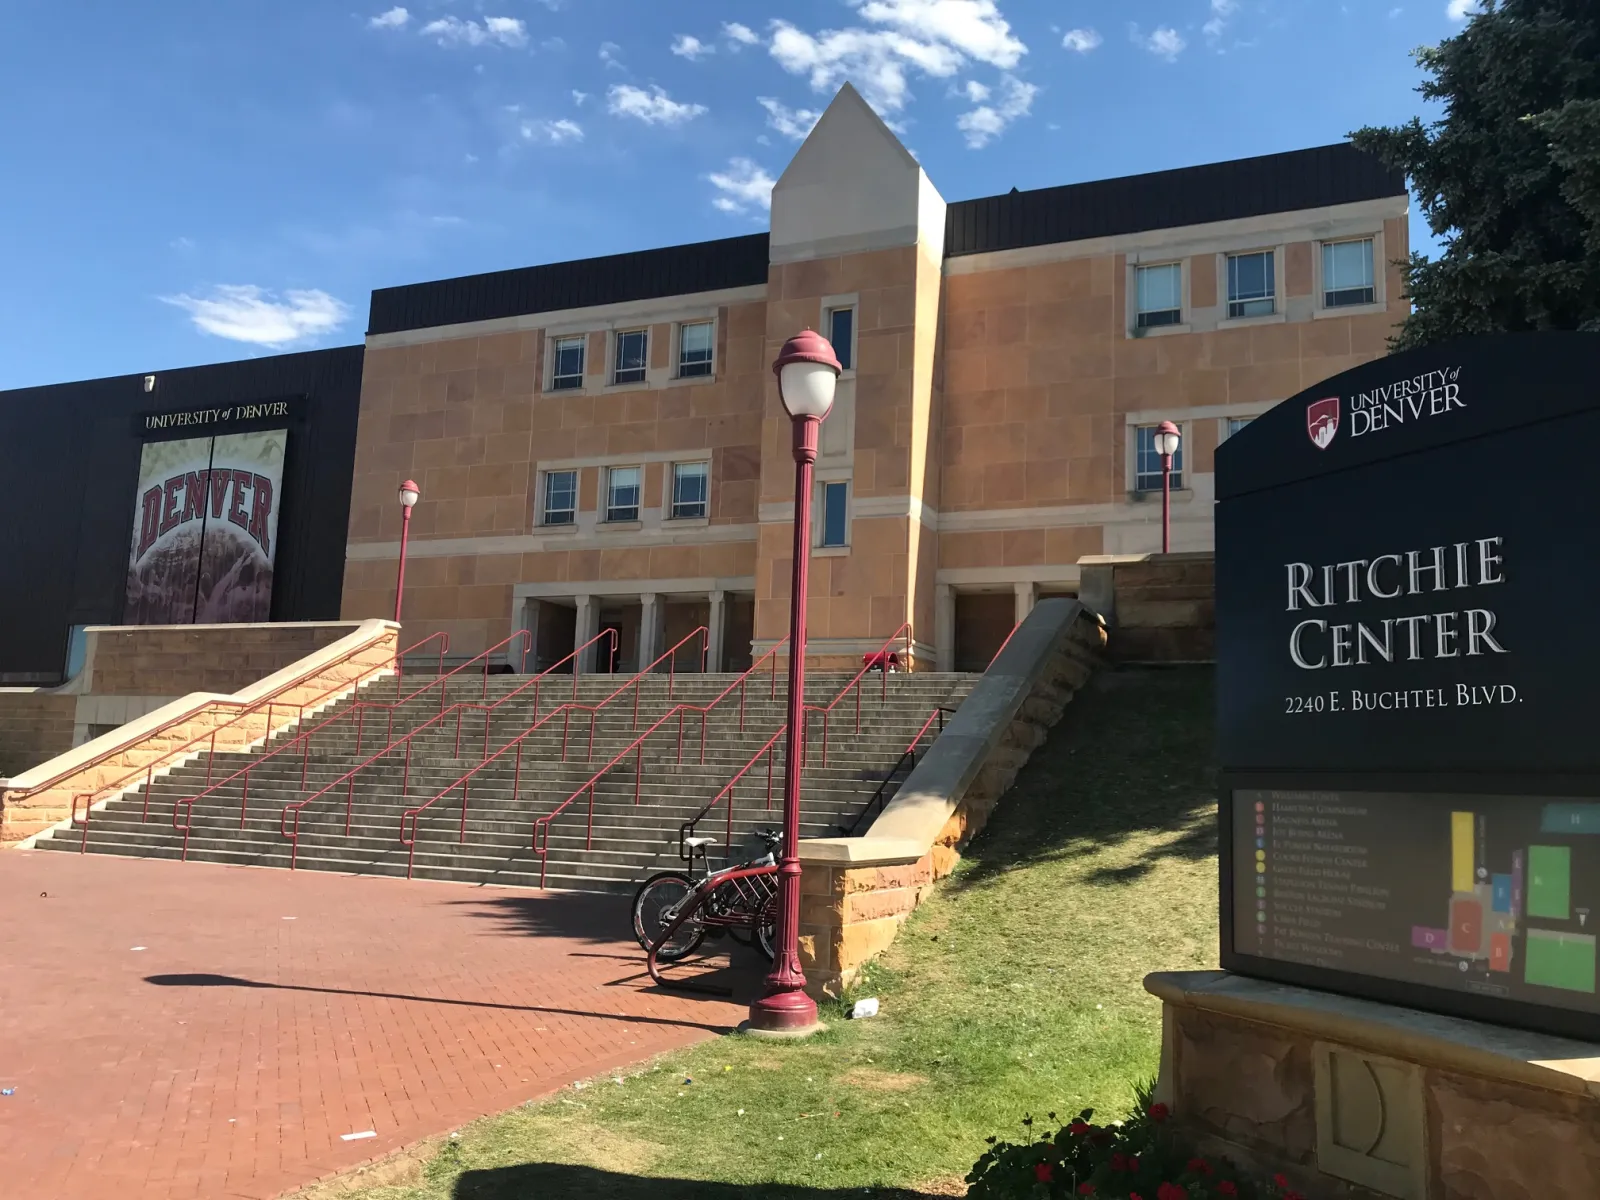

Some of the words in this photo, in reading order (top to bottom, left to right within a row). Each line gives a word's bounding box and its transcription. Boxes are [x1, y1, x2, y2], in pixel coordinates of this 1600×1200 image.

[145, 408, 221, 429] UNIVERSITY
[222, 407, 233, 421] of
[236, 401, 288, 420] DENVER
[1350, 367, 1450, 411] UNIVERSITY
[1449, 366, 1462, 381] of
[1350, 383, 1467, 437] DENVER
[136, 468, 273, 563] DENVER
[1284, 536, 1505, 611] RITCHIE
[1289, 608, 1511, 670] CENTER
[1285, 695, 1325, 714] 2240
[1330, 691, 1346, 712] E.
[1352, 688, 1448, 711] BUCHTEL
[1456, 683, 1523, 706] BLVD.
